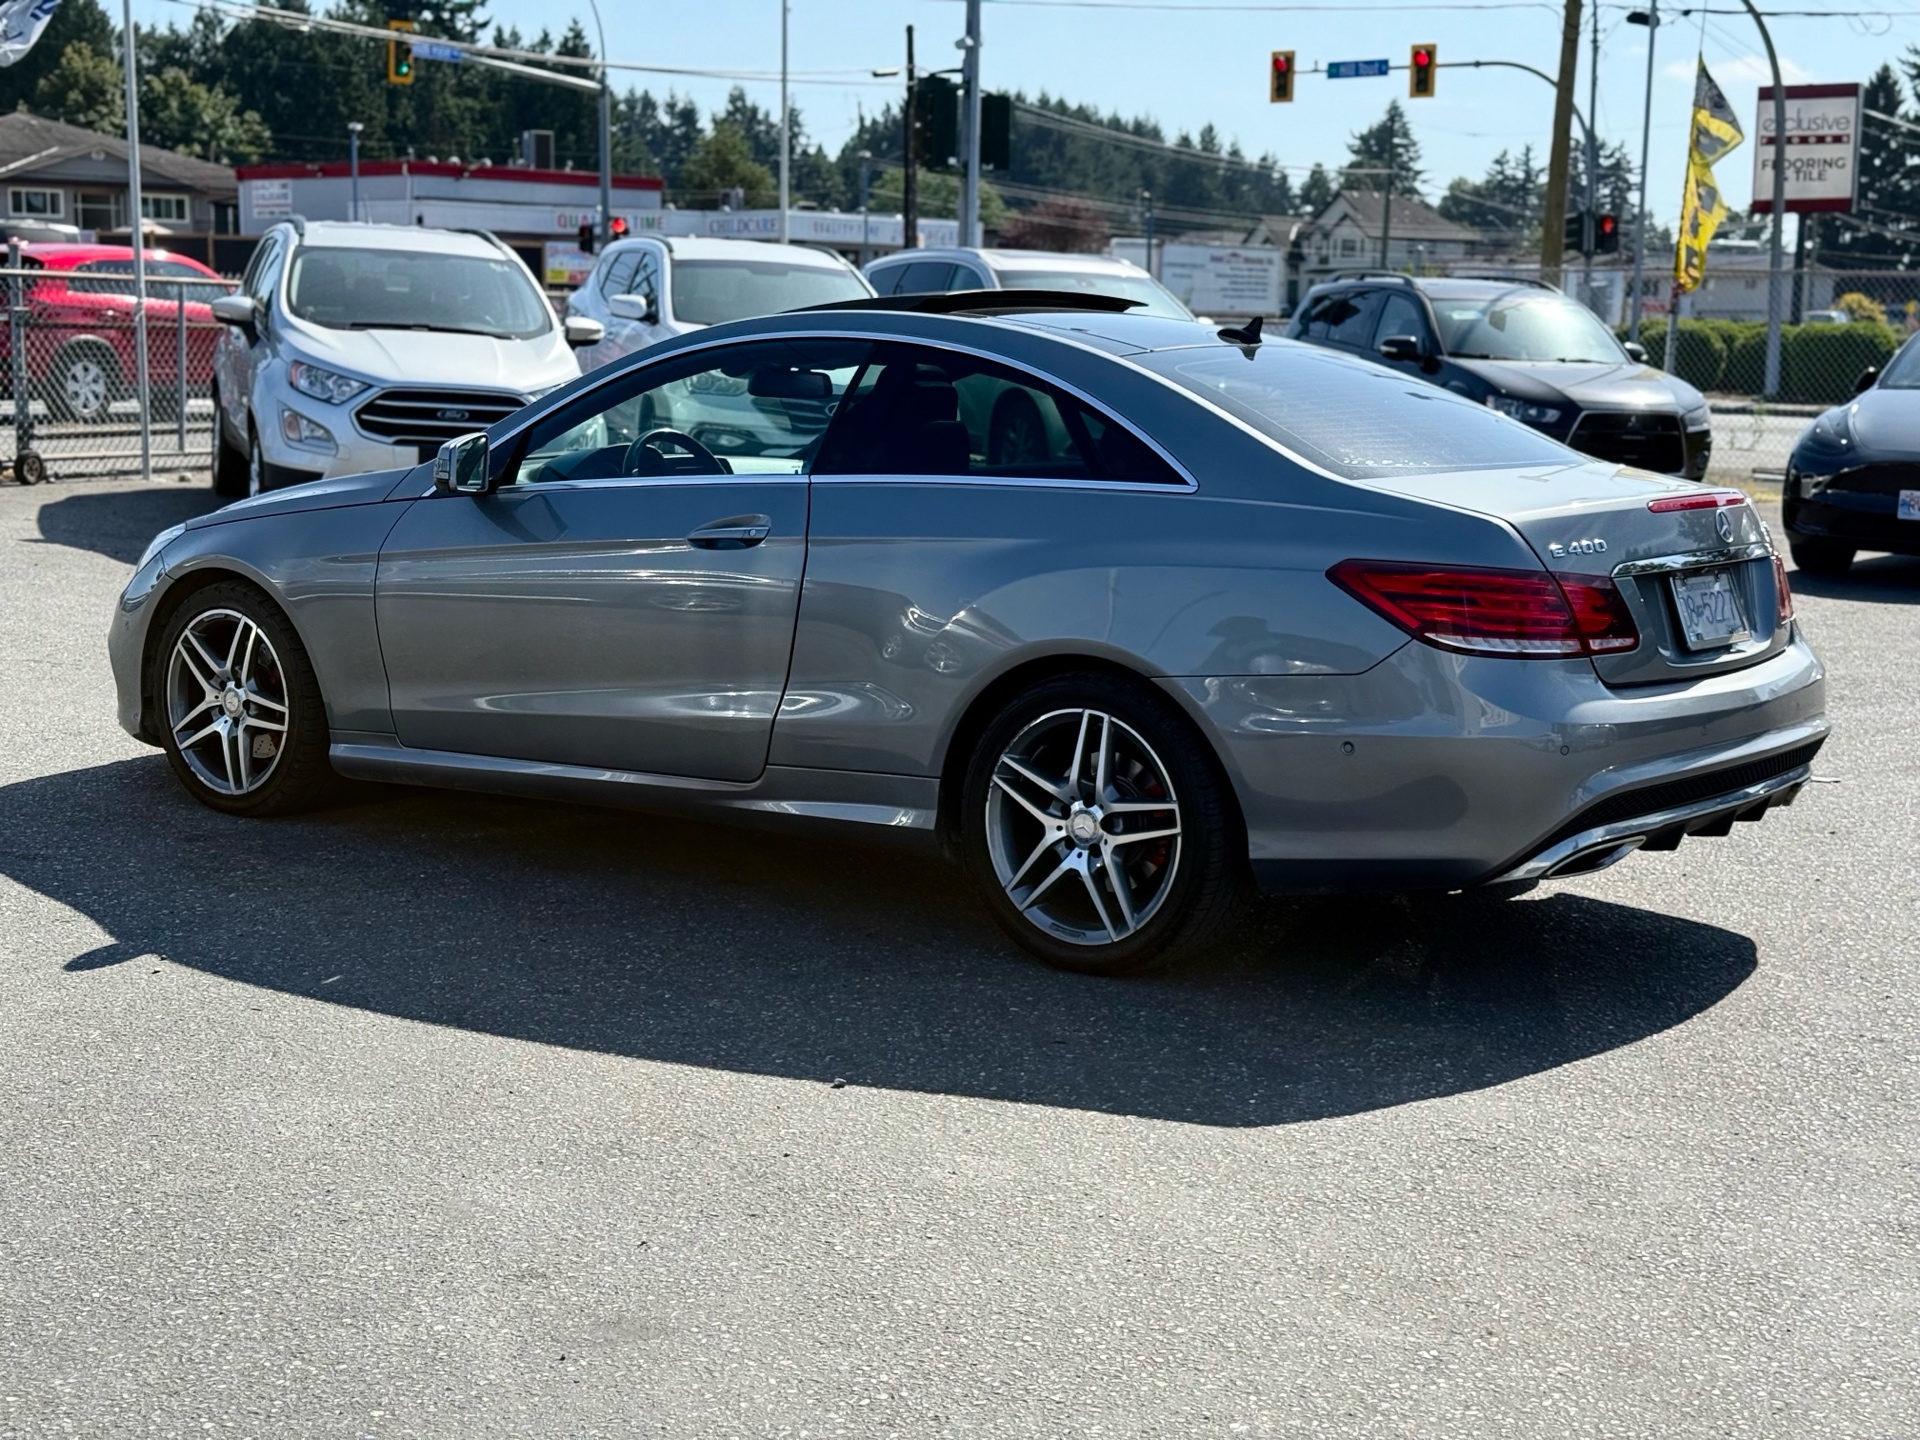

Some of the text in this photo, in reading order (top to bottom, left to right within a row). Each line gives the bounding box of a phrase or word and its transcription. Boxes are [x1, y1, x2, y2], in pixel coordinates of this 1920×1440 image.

[1762, 108, 1850, 132] eclusive
[1794, 169, 1827, 182] TILE
[632, 214, 664, 229] TIME
[1548, 538, 1608, 559] E 400
